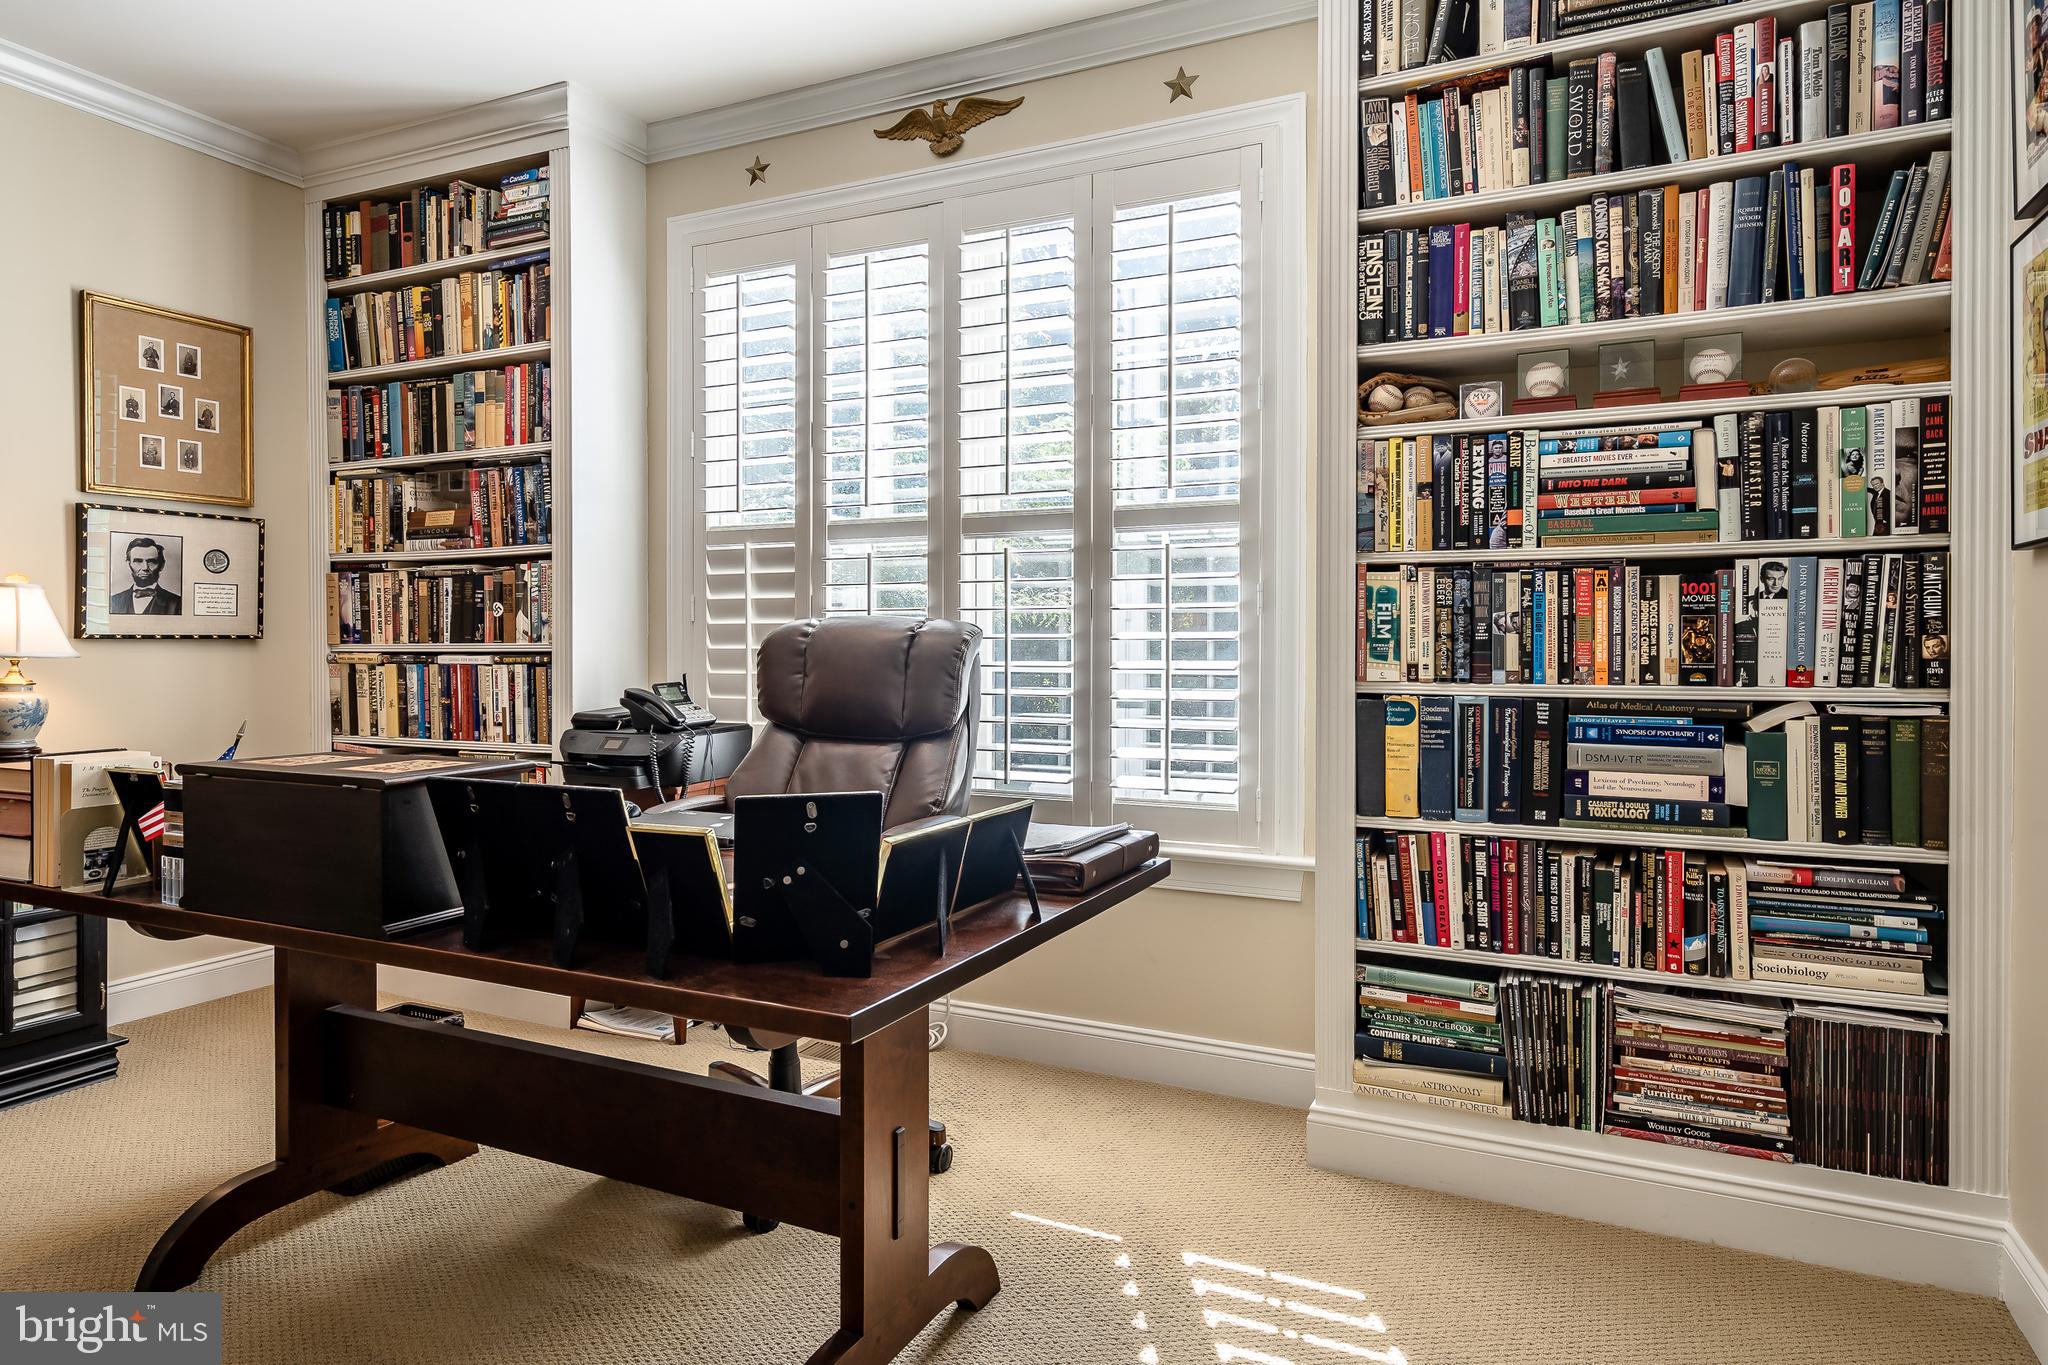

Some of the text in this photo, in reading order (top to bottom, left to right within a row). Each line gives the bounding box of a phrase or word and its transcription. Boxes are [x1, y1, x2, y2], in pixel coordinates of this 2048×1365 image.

[1904, 1, 1912, 51] OF THE AIR
[1913, 7, 1922, 41] EMPIRE
[1719, 39, 1733, 76] Arrogance
[1928, 22, 1944, 86] UNDERBOSS
[1735, 36, 1748, 99] LARRY ELDER
[1803, 62, 1811, 82] Right
[1813, 47, 1822, 97] Tom Wolfe
[1366, 113, 1386, 122] RAND
[1367, 103, 1385, 112] AYN
[1568, 85, 1583, 156] SWORD
[1601, 93, 1610, 147] FREEMASONS
[1736, 101, 1748, 145] SHOWDOWN
[1366, 148, 1380, 191] SHRUGGED
[1379, 147, 1389, 170] ATLAS
[1438, 134, 1447, 190] MATHEMATICS
[510, 173, 529, 183] Canada
[1887, 200, 1895, 210] THE
[1838, 168, 1852, 287] BOGART
[1880, 211, 1891, 234] SCIENCE
[1911, 189, 1935, 263] ON HUMAN NATURE
[1563, 212, 1577, 257] MATHEMATICS
[1644, 232, 1652, 244] OF
[1595, 198, 1610, 298] COSMOS CARL SAGAN
[1652, 231, 1660, 278] THE ASCENT
[1872, 244, 1880, 256] LIFE
[1366, 238, 1383, 310] EINSTEIN
[1359, 311, 1383, 320] Clark
[1472, 392, 1491, 400] MVP
[1927, 403, 1942, 413] FIVE
[364, 402, 373, 443] Andersonville
[1926, 416, 1943, 426] CAME
[1801, 422, 1810, 463] Notorious
[1873, 408, 1885, 471] AMERICAN REBEL
[1926, 429, 1943, 439] BACK
[1509, 436, 1521, 467] ARNIE
[1563, 456, 1591, 464] GREATEST
[1593, 454, 1616, 462] MOVIES
[1472, 445, 1485, 509] ERVING
[1558, 477, 1628, 488] INTO THE DARK
[1748, 435, 1762, 507] LANCASTER
[472, 490, 481, 521] SHERMAN
[1555, 490, 1641, 508] WESTERN
[1564, 505, 1646, 516] Baseball's Great Moments
[1547, 519, 1593, 529] BASEBALL
[1436, 578, 1445, 605] EBERT
[1681, 582, 1716, 594] 1001
[1822, 567, 1839, 630] AMERICAN TITAN
[1904, 560, 1918, 637] JAMES STEWART
[1923, 573, 1942, 618] MITCHUM
[1377, 603, 1392, 638] FILM
[1798, 564, 1808, 661] JOHN WAYNE: AMERICAN
[1587, 701, 1608, 709] Atlas
[1620, 702, 1653, 711] Medical
[1655, 703, 1695, 714] Anatomy
[1616, 728, 1646, 736] SYNOPSIS
[1834, 743, 1847, 819] REPUTATION AND POWER
[1588, 800, 1618, 808] CASARETT
[1625, 801, 1650, 809] DOULL'S
[1588, 808, 1650, 819] TOXICOLOGY
[1475, 852, 1486, 876] RIGHT
[1815, 875, 1847, 883] RUDOLPH
[1857, 878, 1889, 887] GIULIANI
[1438, 890, 1444, 900] TO
[1477, 901, 1488, 928] START
[1757, 962, 1829, 980] Sociobiology
[1791, 951, 1902, 969] CHOOSING to LEAD
[1374, 1013, 1474, 1033] GARDEN SOURCEBOOK
[1370, 1028, 1440, 1045] CONTAINER PLANTS
[1670, 1064, 1734, 1079] Antiques At Home
[1704, 1056, 1730, 1065] CRAFTS
[1356, 1085, 1499, 1115] ANTARCTICA ELIOT PORTER
[1420, 1081, 1483, 1097] ASTRONOMY
[1641, 1087, 1694, 1102] Furniture
[1647, 1121, 1711, 1139] WORLDLY GOODS
